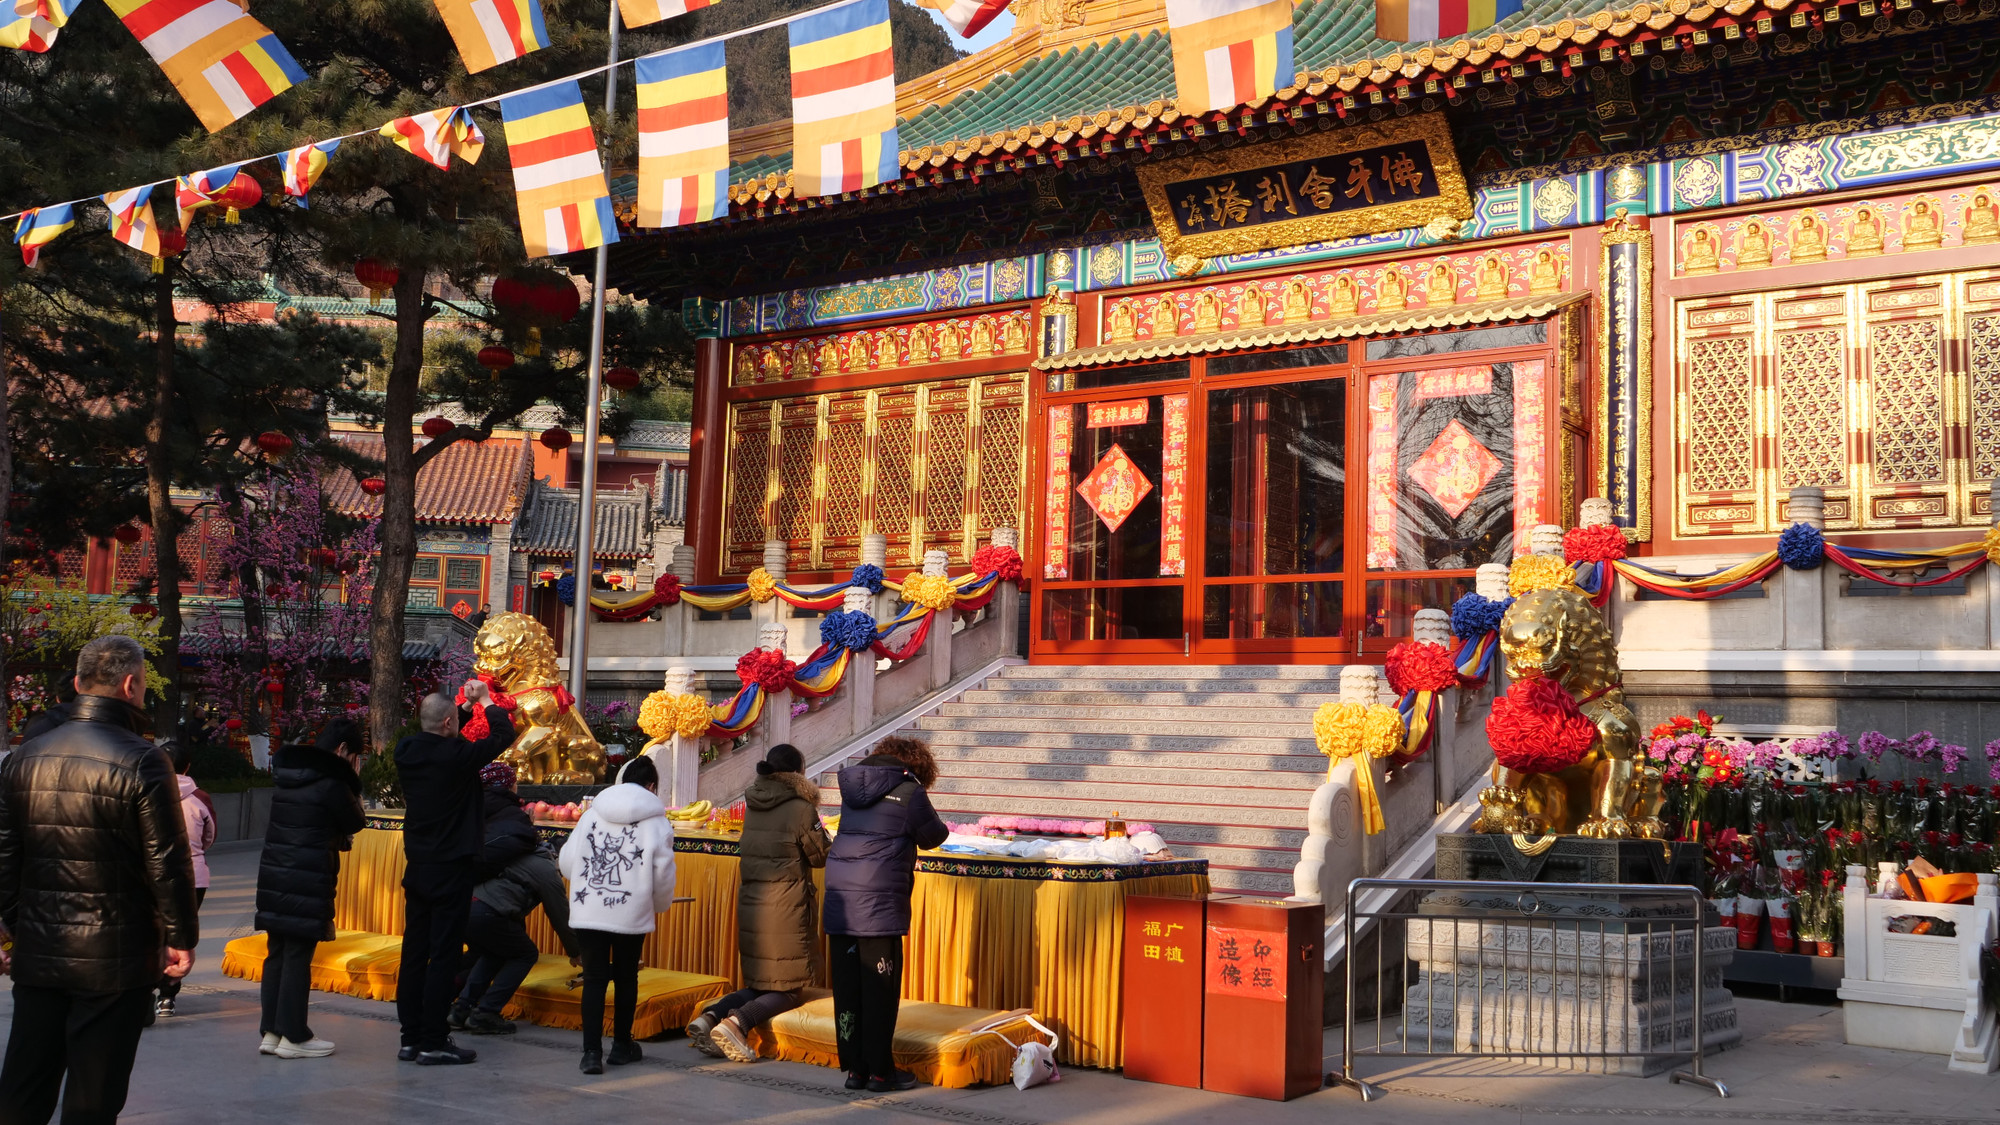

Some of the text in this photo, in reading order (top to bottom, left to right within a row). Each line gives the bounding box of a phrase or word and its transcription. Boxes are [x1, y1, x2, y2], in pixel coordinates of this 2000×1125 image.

[1203, 152, 1423, 227] 佛牙舍利塔
[1142, 920, 1161, 960] 福田
[1164, 923, 1184, 963] 广植
[1218, 937, 1242, 987] 造像
[1252, 939, 1273, 988] 印經
